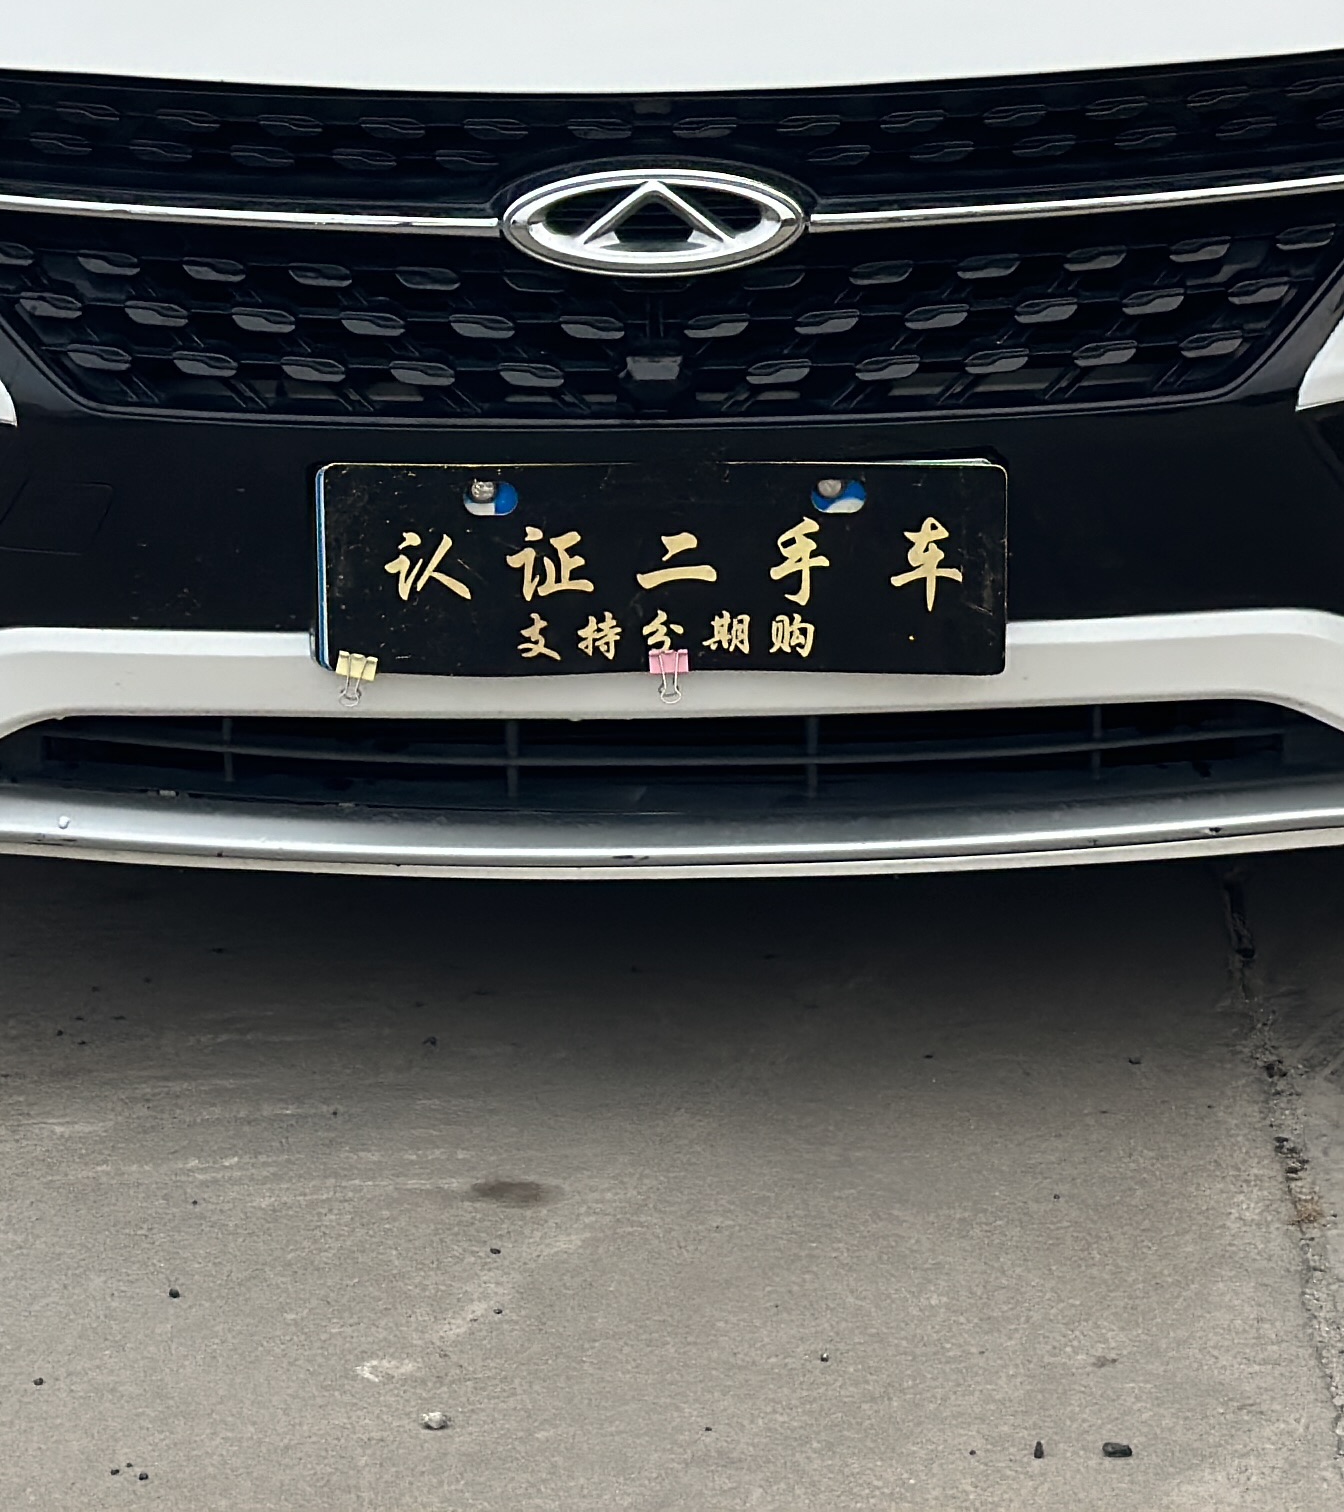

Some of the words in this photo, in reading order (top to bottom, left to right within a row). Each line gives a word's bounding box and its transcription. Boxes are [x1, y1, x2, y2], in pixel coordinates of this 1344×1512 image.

[383, 516, 964, 612] 认证二手车
[517, 609, 816, 661] 支持分期购
